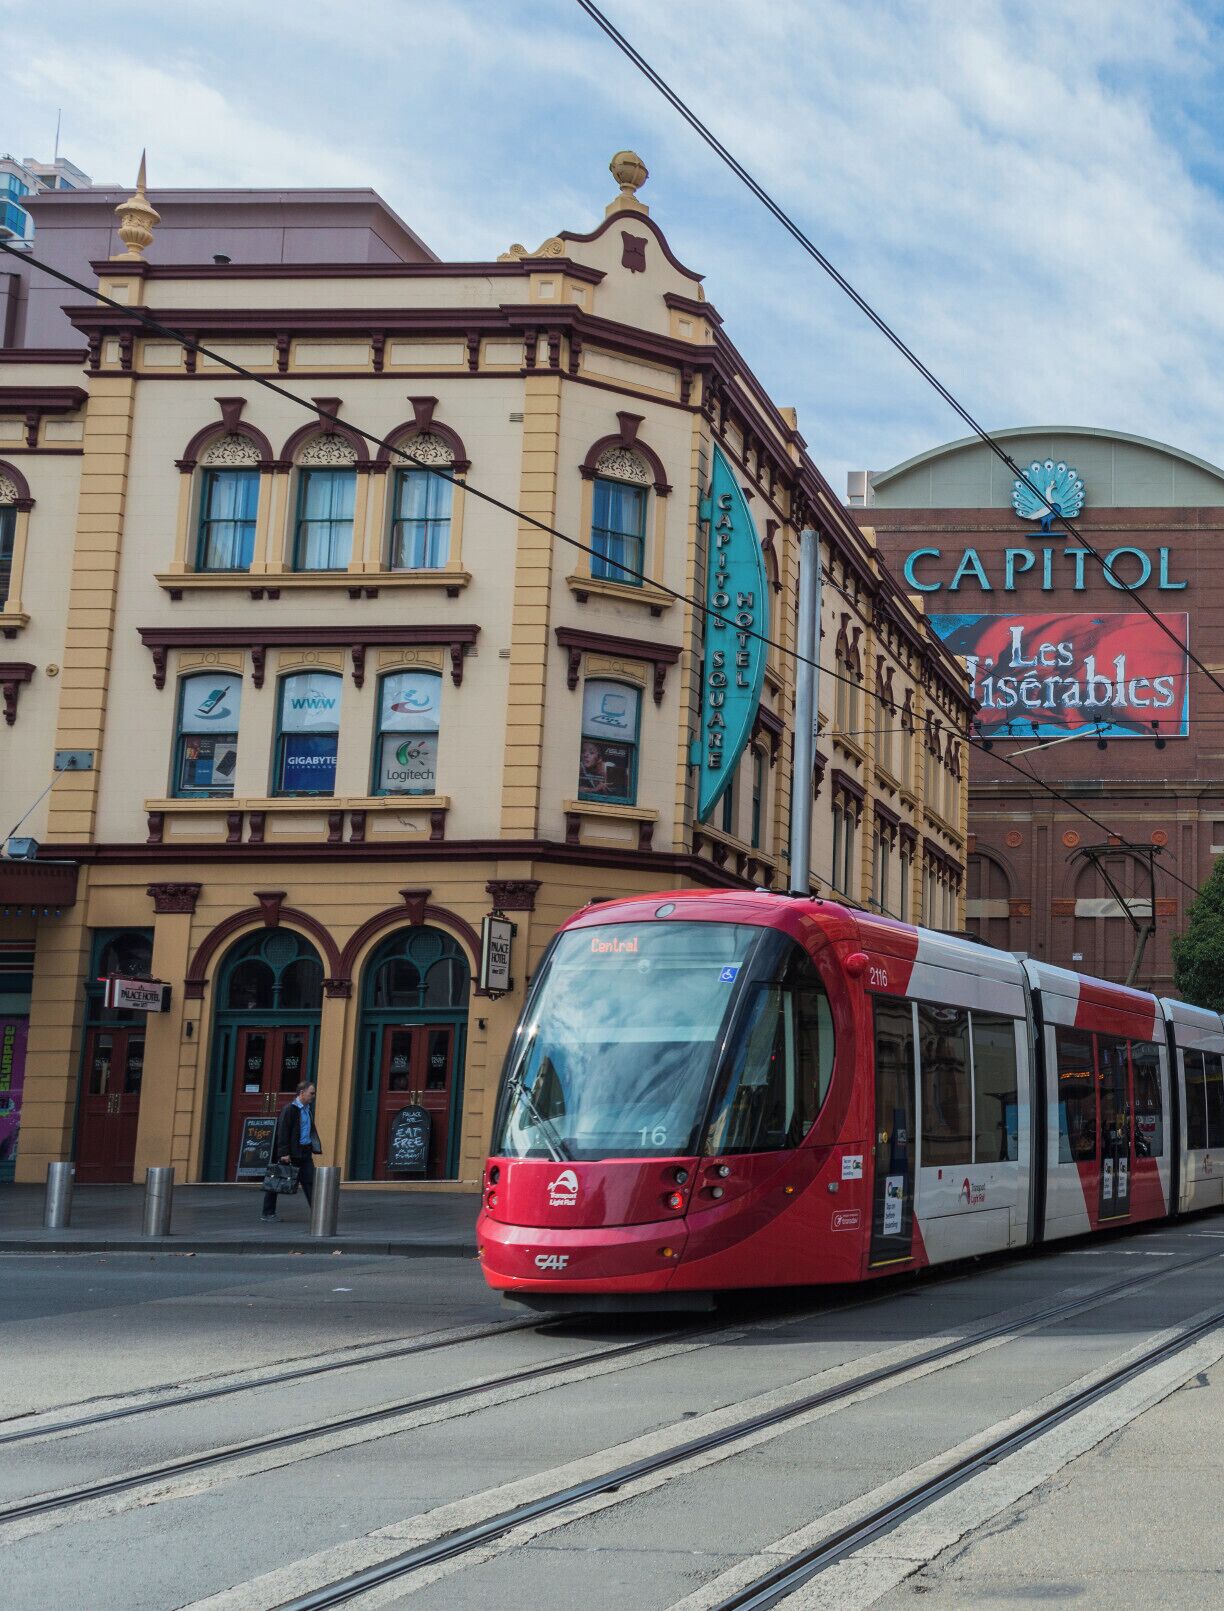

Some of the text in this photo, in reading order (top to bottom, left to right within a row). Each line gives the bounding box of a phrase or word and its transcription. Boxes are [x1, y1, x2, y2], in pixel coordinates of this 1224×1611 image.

[903, 547, 1189, 591] CAPITOL
[707, 493, 733, 770] CAPITOL SQUARE
[736, 592, 754, 687] HOTEL
[1008, 625, 1074, 668] Les
[287, 756, 337, 765] GIGABYTE
[387, 769, 434, 783] Logitech
[591, 936, 639, 953] Central
[491, 953, 507, 965] HOTEL
[870, 966, 888, 987] 2116
[395, 1127, 422, 1137] EAT
[638, 1126, 667, 1146] 16
[393, 1136, 423, 1148] FREE
[535, 1255, 569, 1270] CAF
